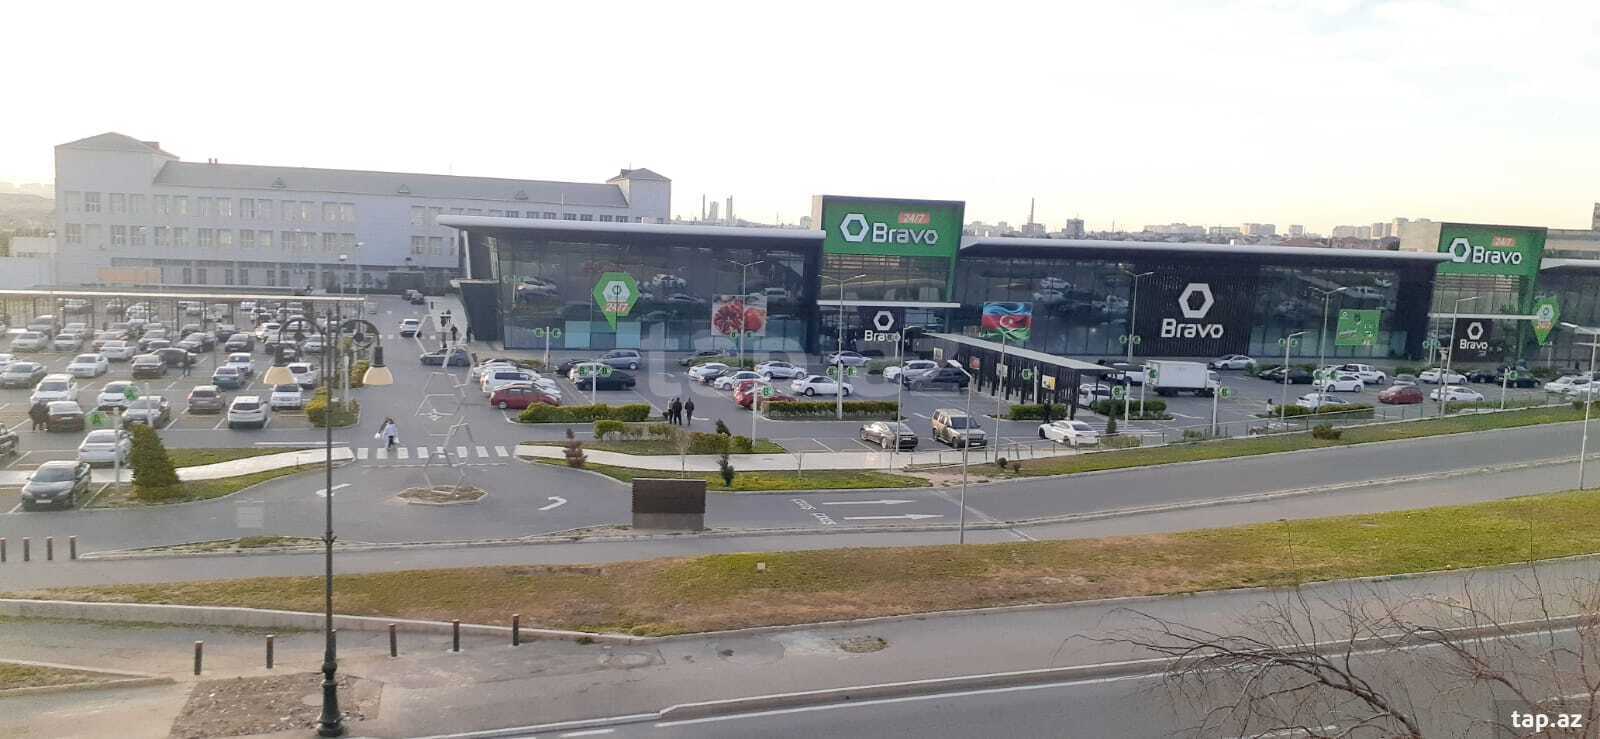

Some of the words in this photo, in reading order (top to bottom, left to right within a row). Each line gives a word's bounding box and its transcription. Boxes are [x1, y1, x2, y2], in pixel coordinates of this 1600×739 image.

[872, 222, 939, 244] Bravo
[1472, 246, 1522, 264] Bravo
[1160, 318, 1224, 338] Bravo
[1459, 339, 1488, 350] Bravo
